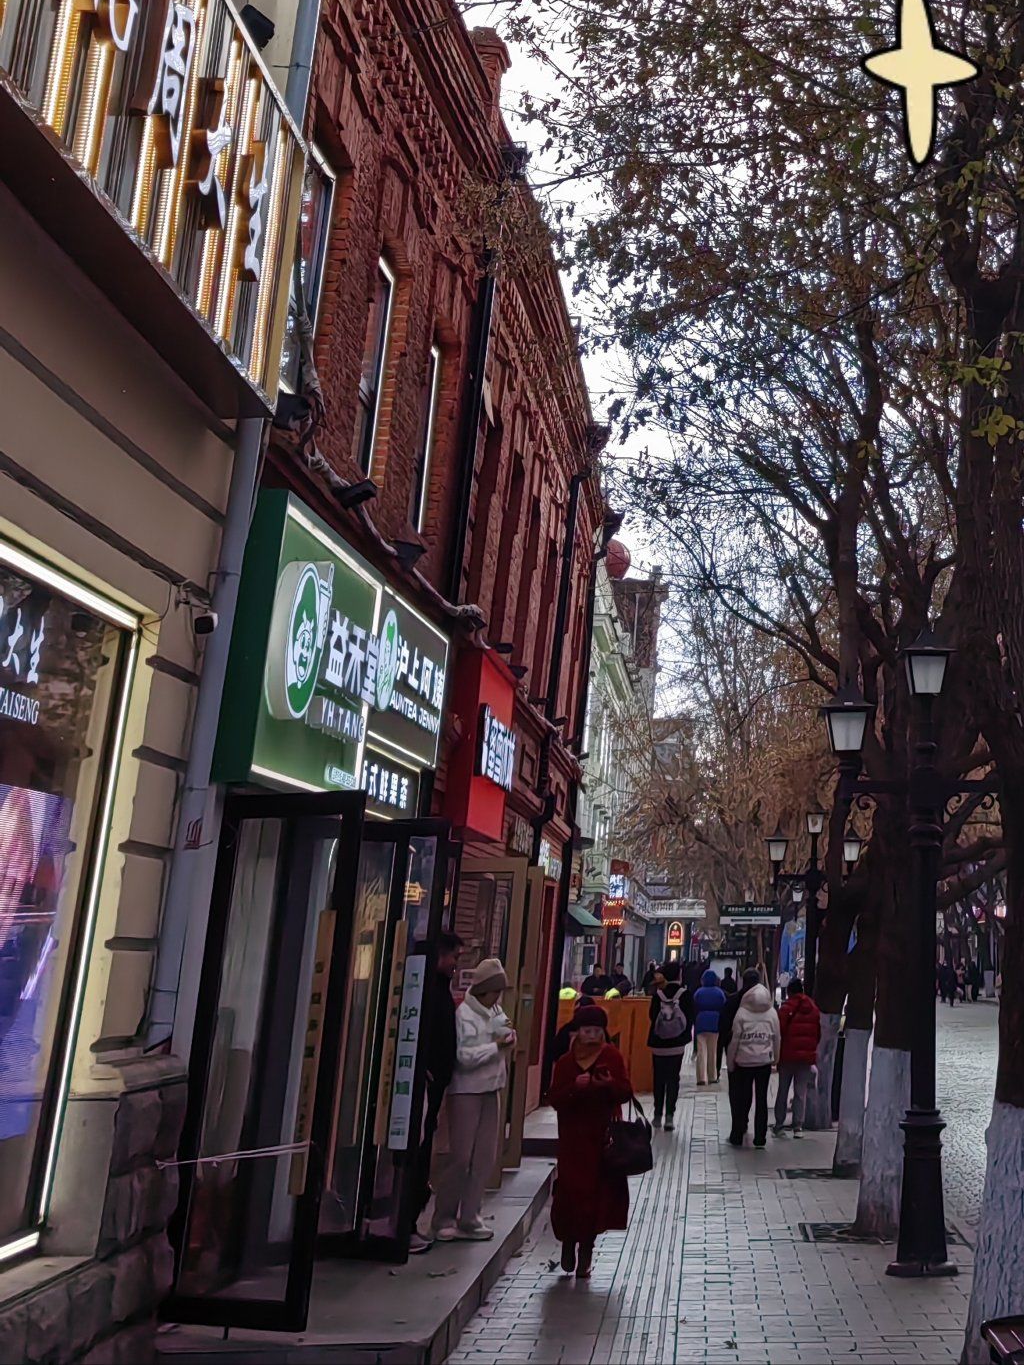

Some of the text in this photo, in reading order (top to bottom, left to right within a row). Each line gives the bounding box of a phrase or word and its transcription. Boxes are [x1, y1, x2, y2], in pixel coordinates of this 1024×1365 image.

[0, 596, 45, 685] 大生
[325, 610, 380, 707] 益禾堂
[396, 634, 445, 710] 沪上阿姨
[389, 690, 440, 734] AUNTEA JENNY
